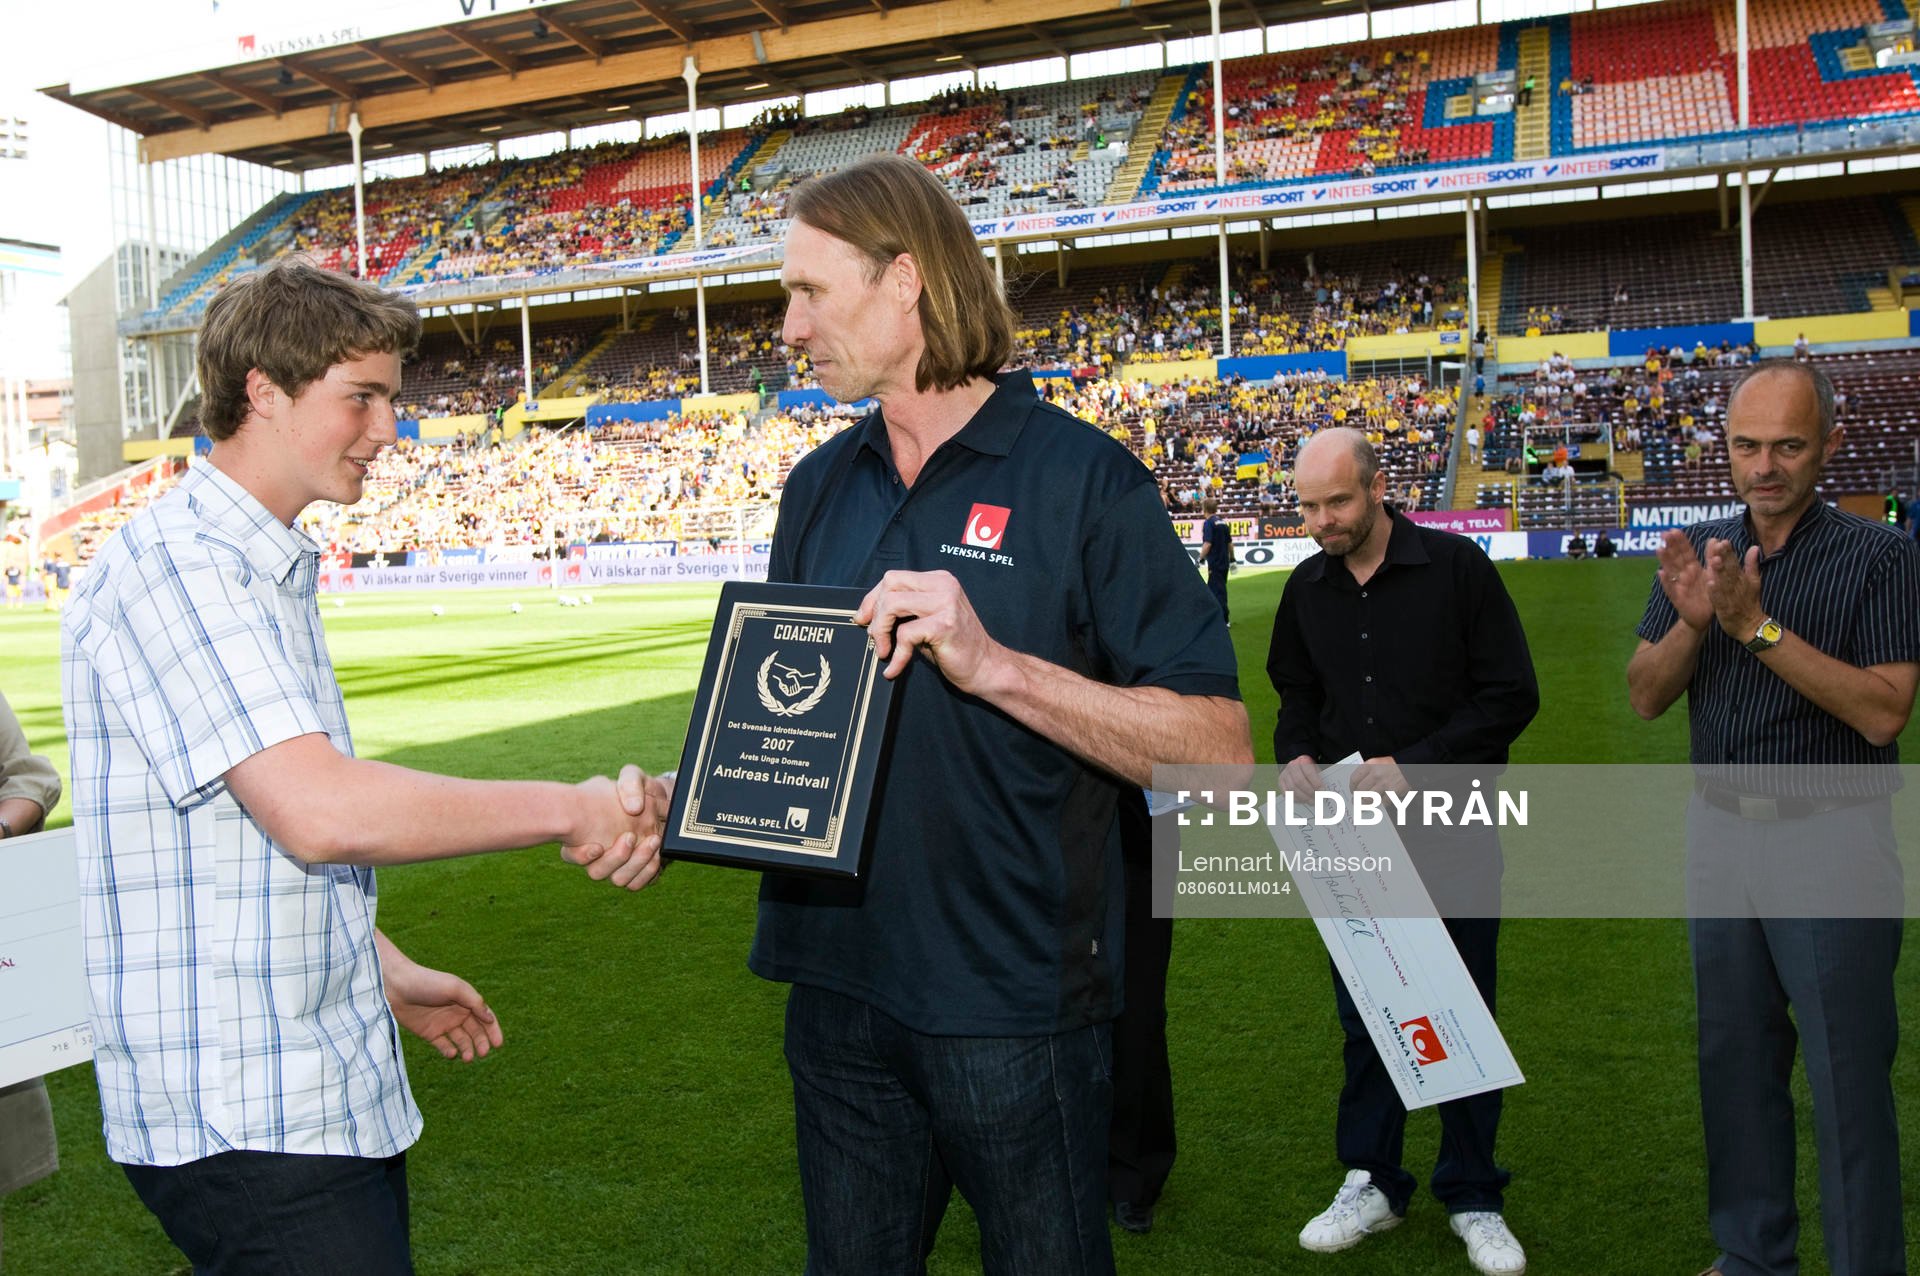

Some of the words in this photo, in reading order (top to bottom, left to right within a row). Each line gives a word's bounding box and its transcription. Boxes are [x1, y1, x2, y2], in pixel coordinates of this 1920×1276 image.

[261, 33, 325, 57] SVENSKA
[331, 26, 364, 44] SPEL
[1560, 154, 1659, 176] INTERSPORT
[1441, 166, 1535, 187] INTERSPORT
[1328, 178, 1417, 200] INTERSPORT
[1219, 190, 1305, 209] INTERSPORT
[1117, 201, 1197, 220] INTERSPORT
[1016, 213, 1096, 231] INTERSPORT
[1264, 523, 1306, 540] Swed
[1467, 519, 1502, 529] TELIA
[940, 544, 986, 560] SVENSKA
[989, 553, 1014, 566] SPEL
[362, 574, 374, 585] Vi
[377, 572, 412, 585] älskar
[416, 571, 435, 583] när
[440, 570, 485, 585] Sverige
[489, 569, 528, 581] vinner
[590, 566, 602, 577] Vi
[607, 564, 646, 577] älskar
[651, 564, 671, 576] när
[677, 562, 728, 577] Sverige
[732, 563, 769, 574] vnne
[773, 624, 834, 644] COACHEN
[728, 721, 740, 730] Det
[741, 722, 772, 733] Svenska
[773, 725, 837, 740] Idrottsledarpriset
[761, 737, 795, 752] 2007
[739, 751, 760, 762] Årets
[760, 754, 780, 766] Unga
[781, 756, 810, 768] Domare
[713, 764, 769, 783] Andreas
[774, 771, 830, 790] Lindvall
[716, 812, 758, 827] SVENSKA
[760, 816, 782, 829] SPEL
[1380, 1005, 1413, 1057] SVENSKA
[1407, 1058, 1427, 1087] SPEL
